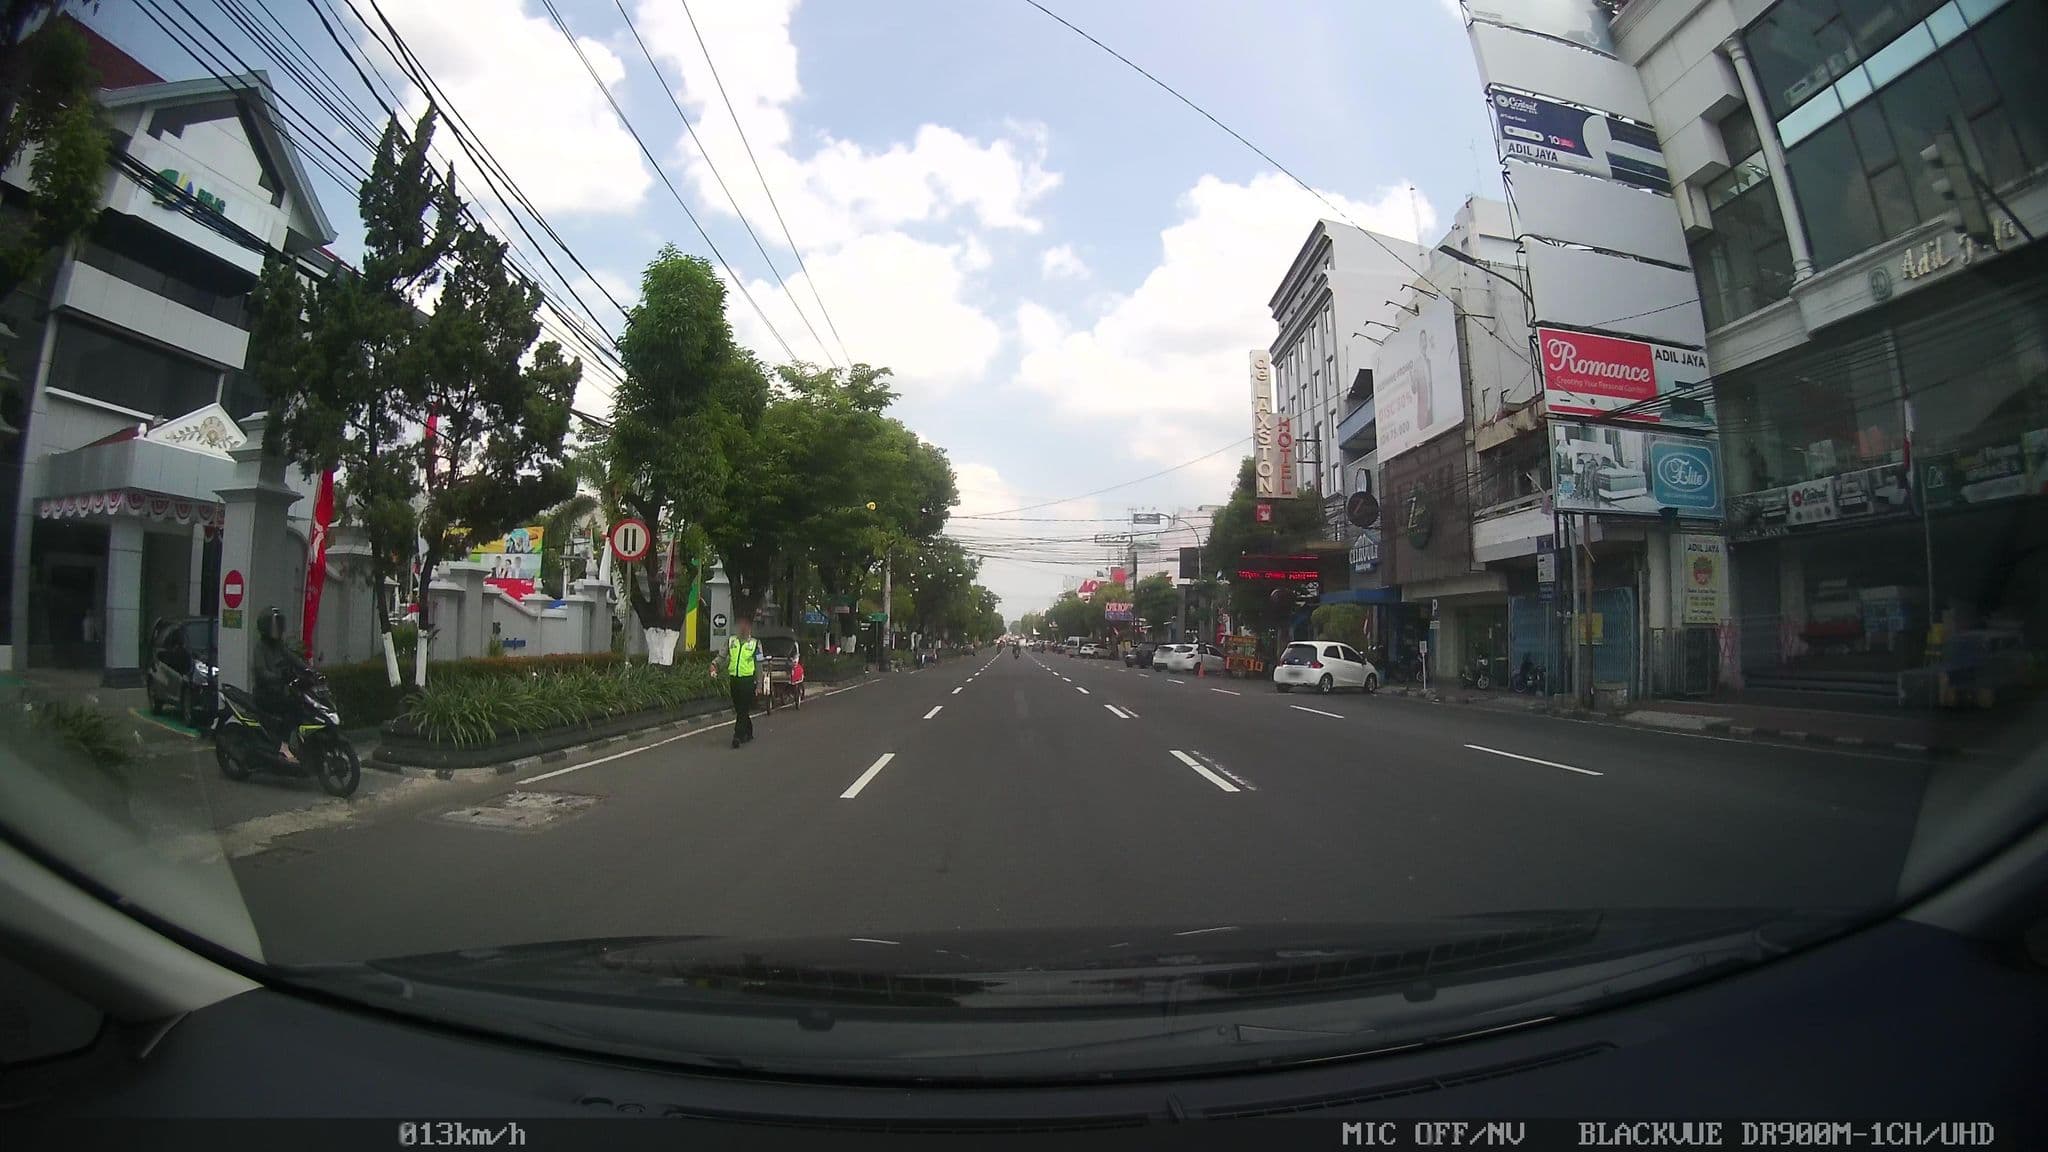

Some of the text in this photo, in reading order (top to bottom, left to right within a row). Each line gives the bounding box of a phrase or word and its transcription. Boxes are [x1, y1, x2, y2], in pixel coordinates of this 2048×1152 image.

[1508, 142, 1558, 163] ADIL JAYA
[1901, 236, 1953, 281] Adil
[1547, 338, 1651, 383] Romance
[1654, 349, 1706, 369] ADIL JAYA
[1277, 416, 1292, 495] HOTEL
[1664, 457, 1704, 486] Elite
